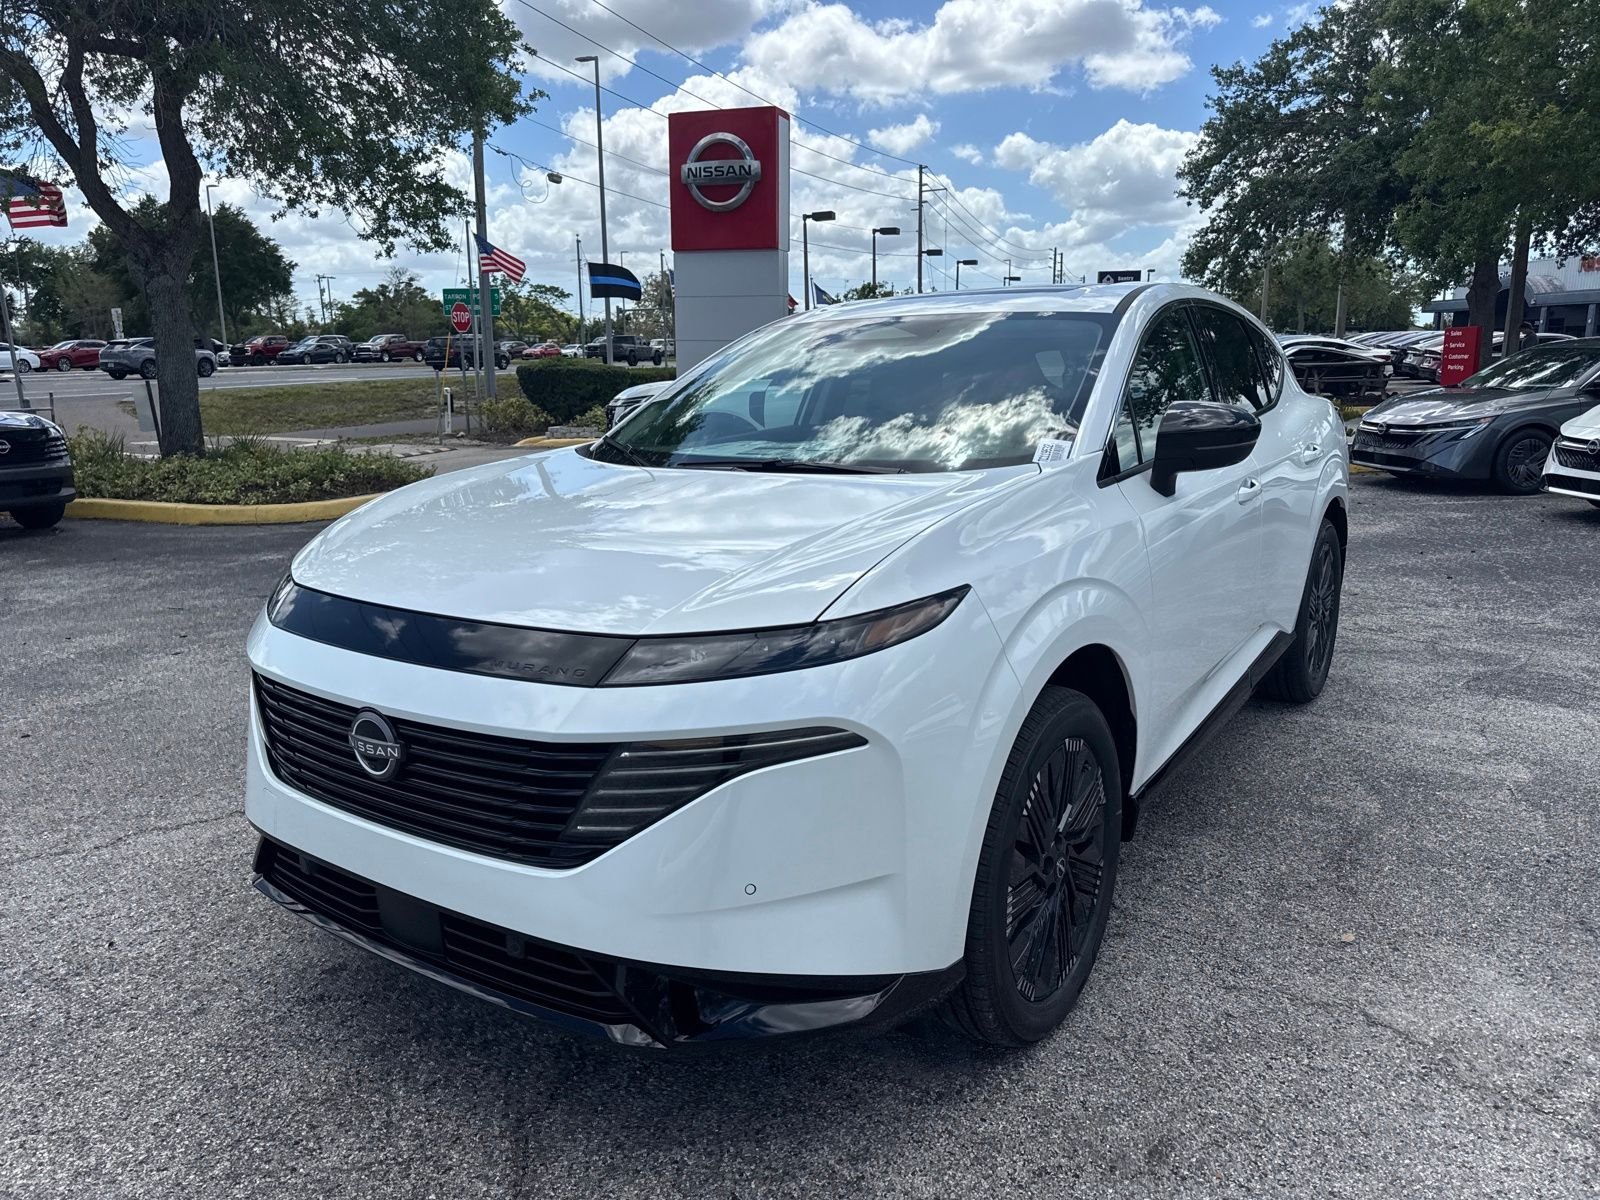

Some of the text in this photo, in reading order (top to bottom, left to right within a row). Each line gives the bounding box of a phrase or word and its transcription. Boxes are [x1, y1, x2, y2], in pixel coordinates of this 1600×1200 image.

[687, 165, 752, 179] NISSAN
[452, 311, 470, 323] STOP
[1447, 363, 1464, 371] Parking
[490, 660, 587, 678] MURANO
[348, 735, 398, 757] NISSAN
